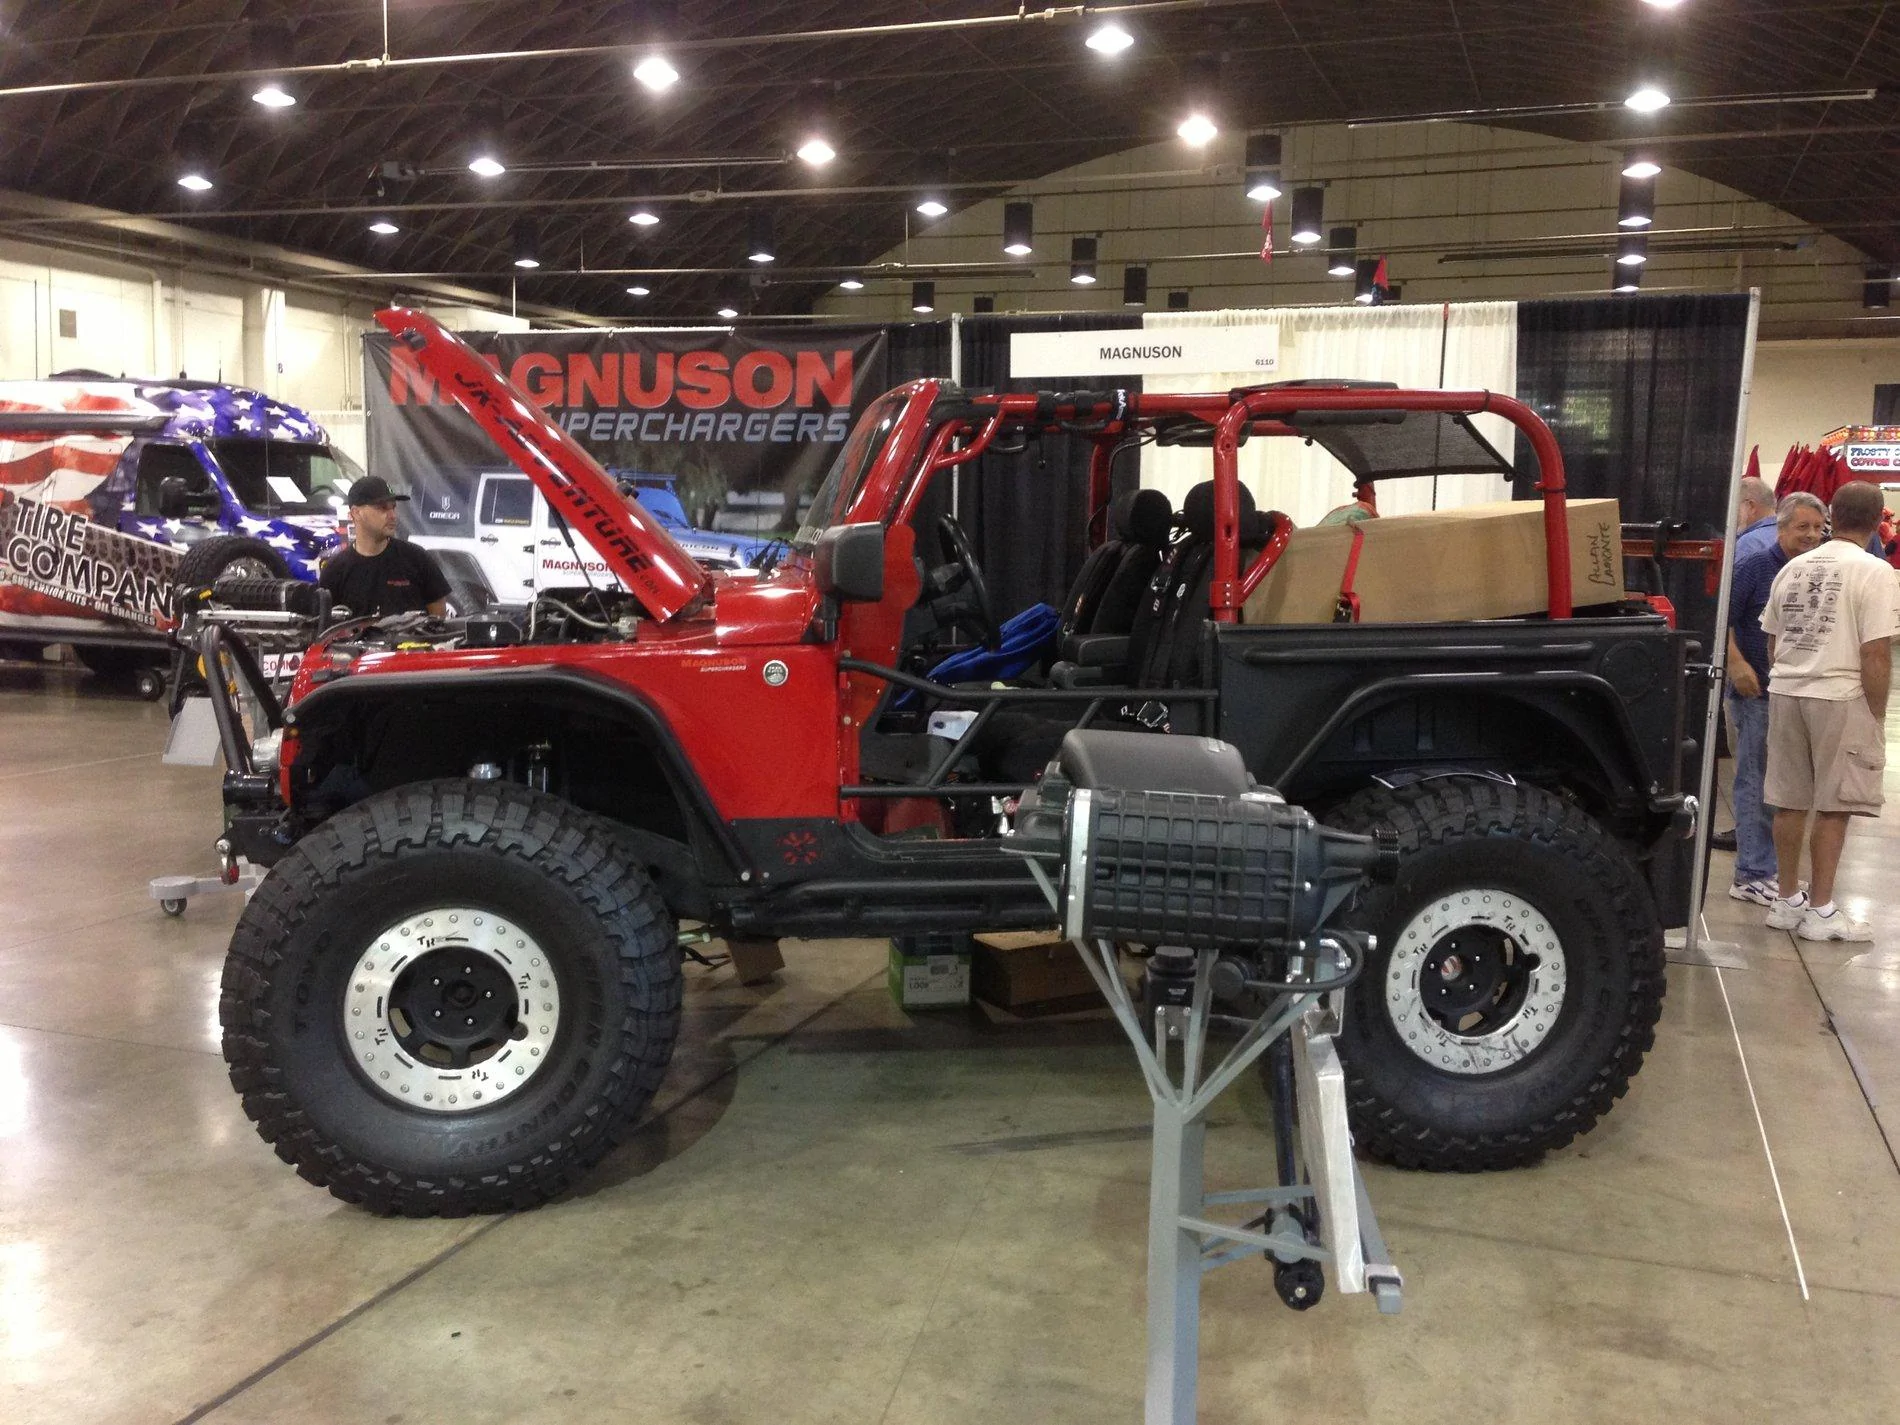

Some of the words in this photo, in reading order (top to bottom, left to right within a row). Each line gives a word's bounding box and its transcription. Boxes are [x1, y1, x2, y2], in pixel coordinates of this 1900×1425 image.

[1100, 346, 1182, 360] MAGNUSON
[1255, 358, 1274, 366] 6110
[390, 347, 853, 410] MGNUSON
[556, 411, 851, 443] PERCHARGERS
[17, 497, 88, 555] TIRE
[429, 511, 460, 520] OMEGA
[7, 536, 174, 622] COMPAN
[11, 573, 65, 601] SUSPENSION
[65, 591, 87, 607] KITS
[94, 602, 111, 615] OIL
[111, 606, 157, 627] CHANGES
